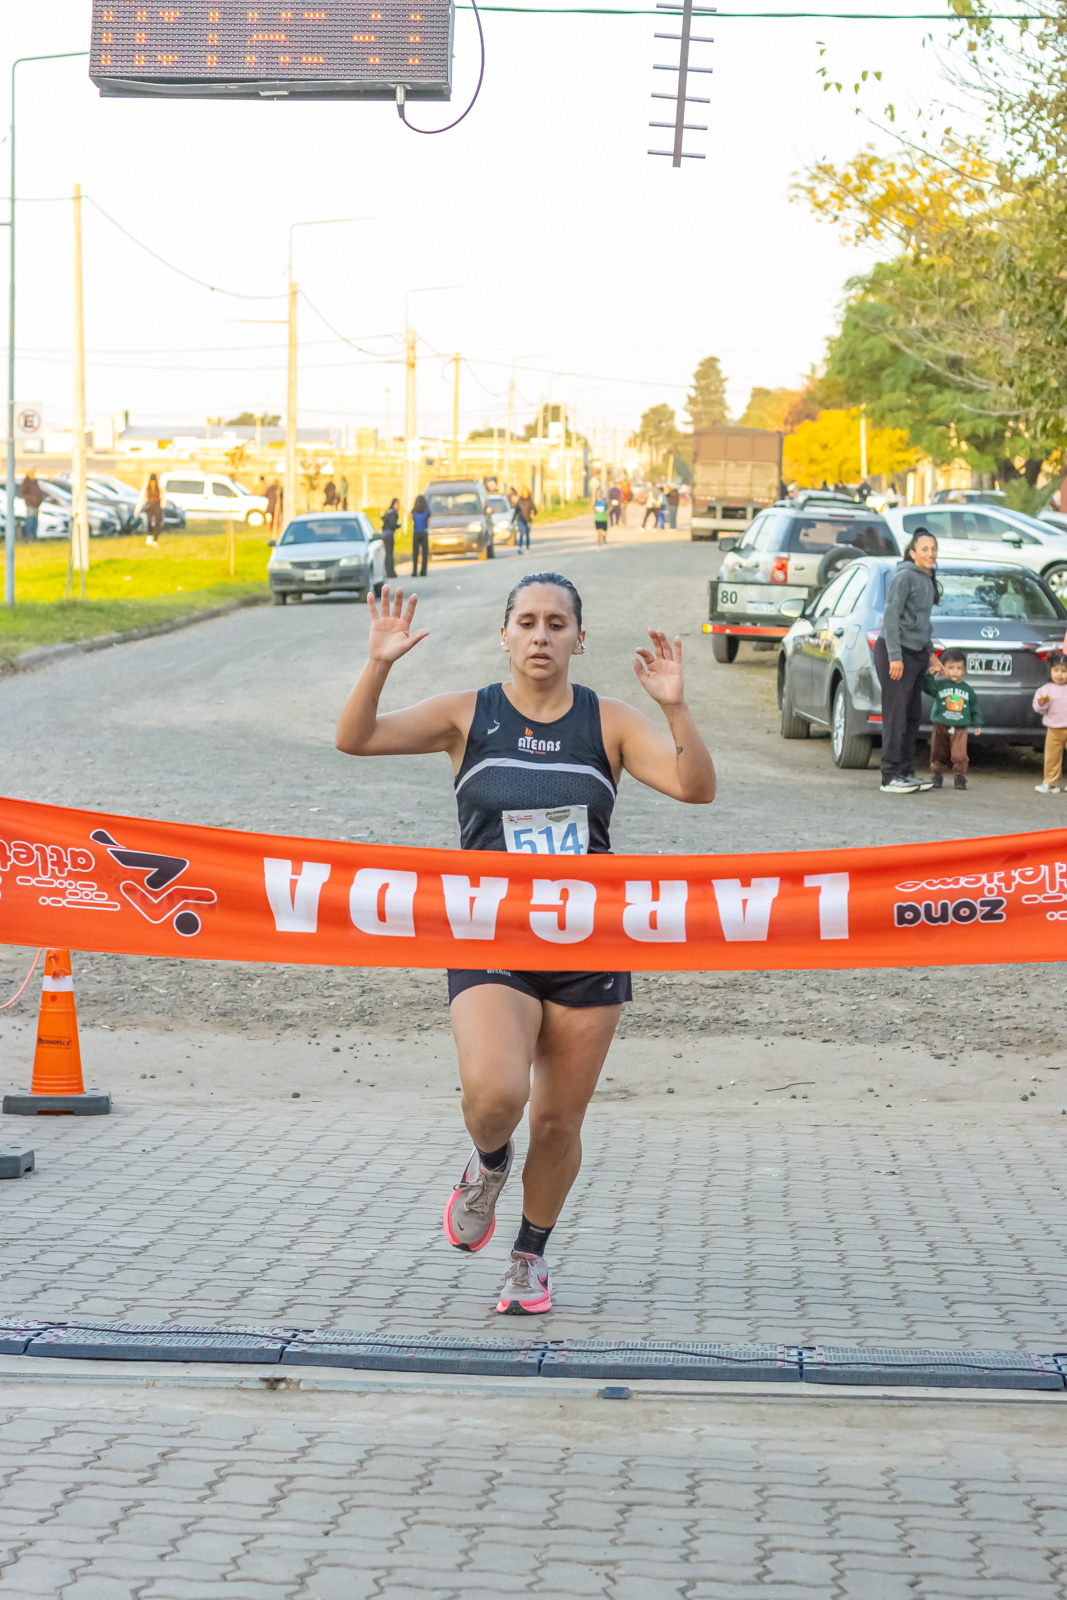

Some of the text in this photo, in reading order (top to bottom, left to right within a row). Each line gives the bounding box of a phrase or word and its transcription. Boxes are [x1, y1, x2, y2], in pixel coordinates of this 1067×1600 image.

[720, 590, 738, 604] 80
[969, 659, 1010, 671] PKT 477
[518, 736, 561, 752] ATENAS
[513, 823, 584, 854] 514
[263, 857, 850, 943] LARGADA
[894, 897, 1007, 927] zona
